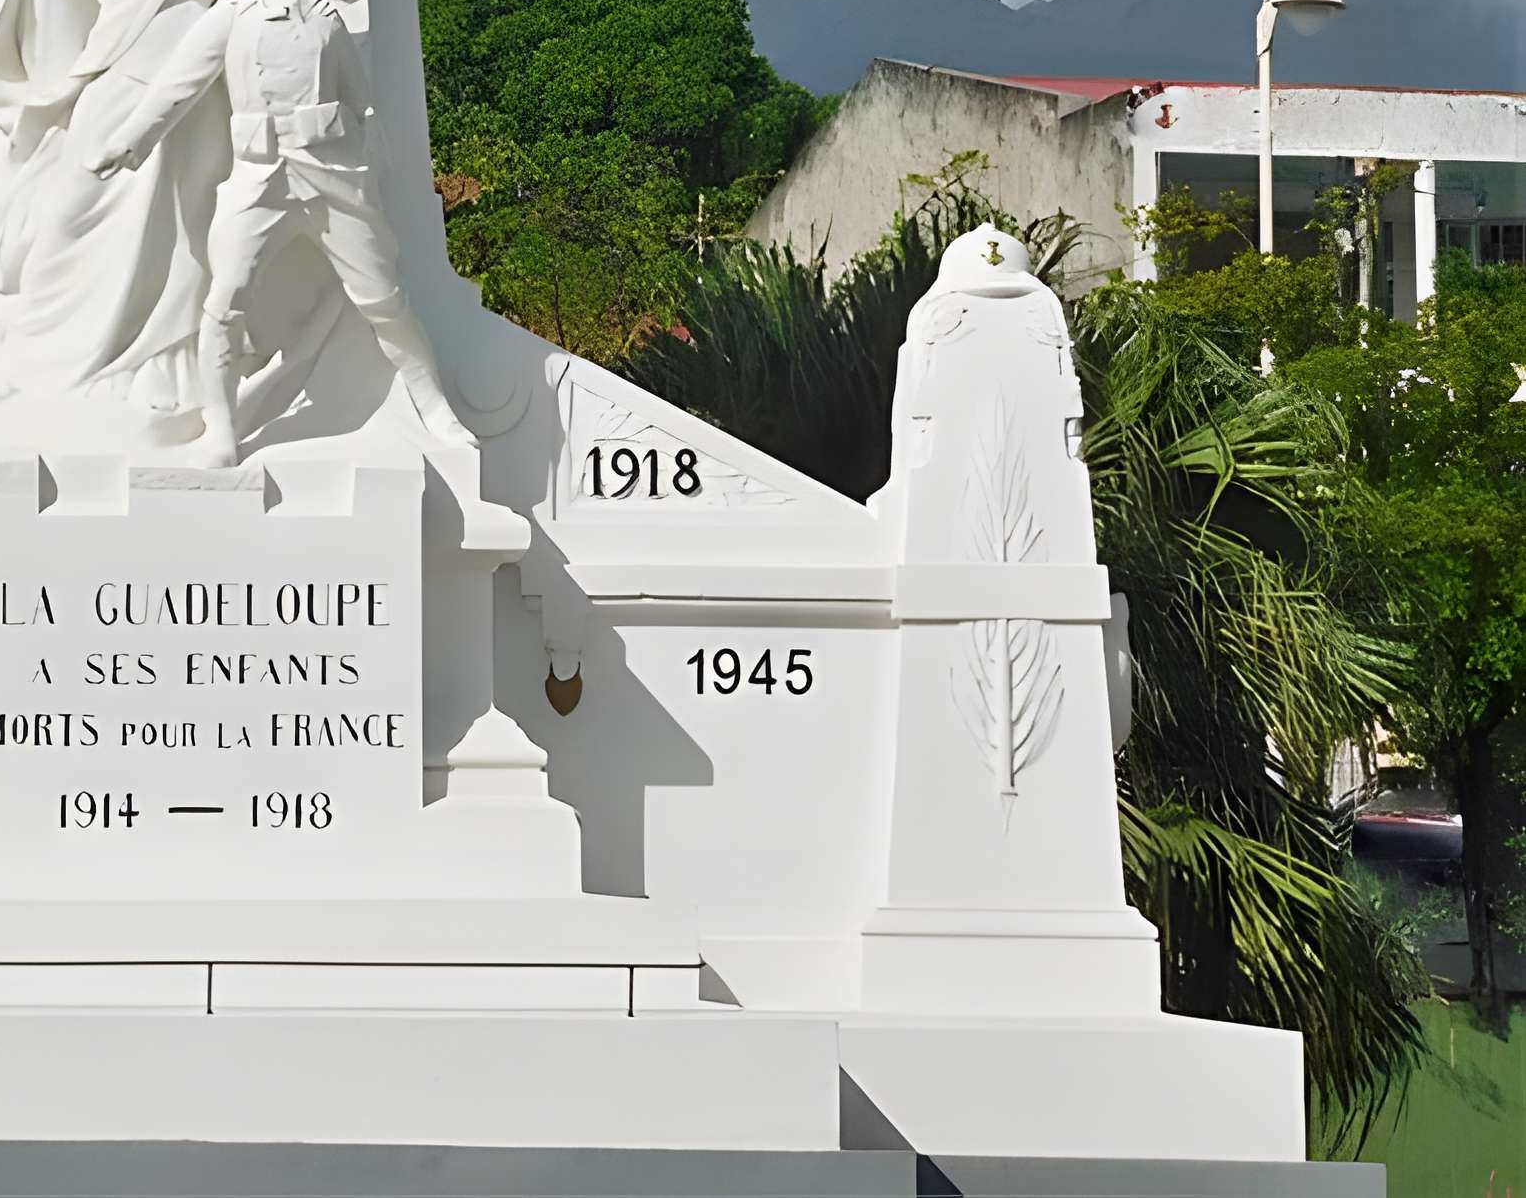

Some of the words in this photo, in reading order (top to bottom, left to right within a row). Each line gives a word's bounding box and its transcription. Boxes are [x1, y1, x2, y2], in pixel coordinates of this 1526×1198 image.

[584, 445, 702, 499] 1918
[1, 582, 56, 626] LA
[94, 582, 391, 627] GUADELOUPE
[31, 657, 53, 685] A
[83, 652, 158, 686] SES
[185, 652, 360, 686] ENFANTS
[685, 647, 814, 696] 1945
[120, 722, 197, 749] POUR
[217, 722, 252, 749] LA
[270, 713, 406, 749] FRANCE
[59, 790, 141, 829] 1914
[251, 790, 334, 830] 1918
